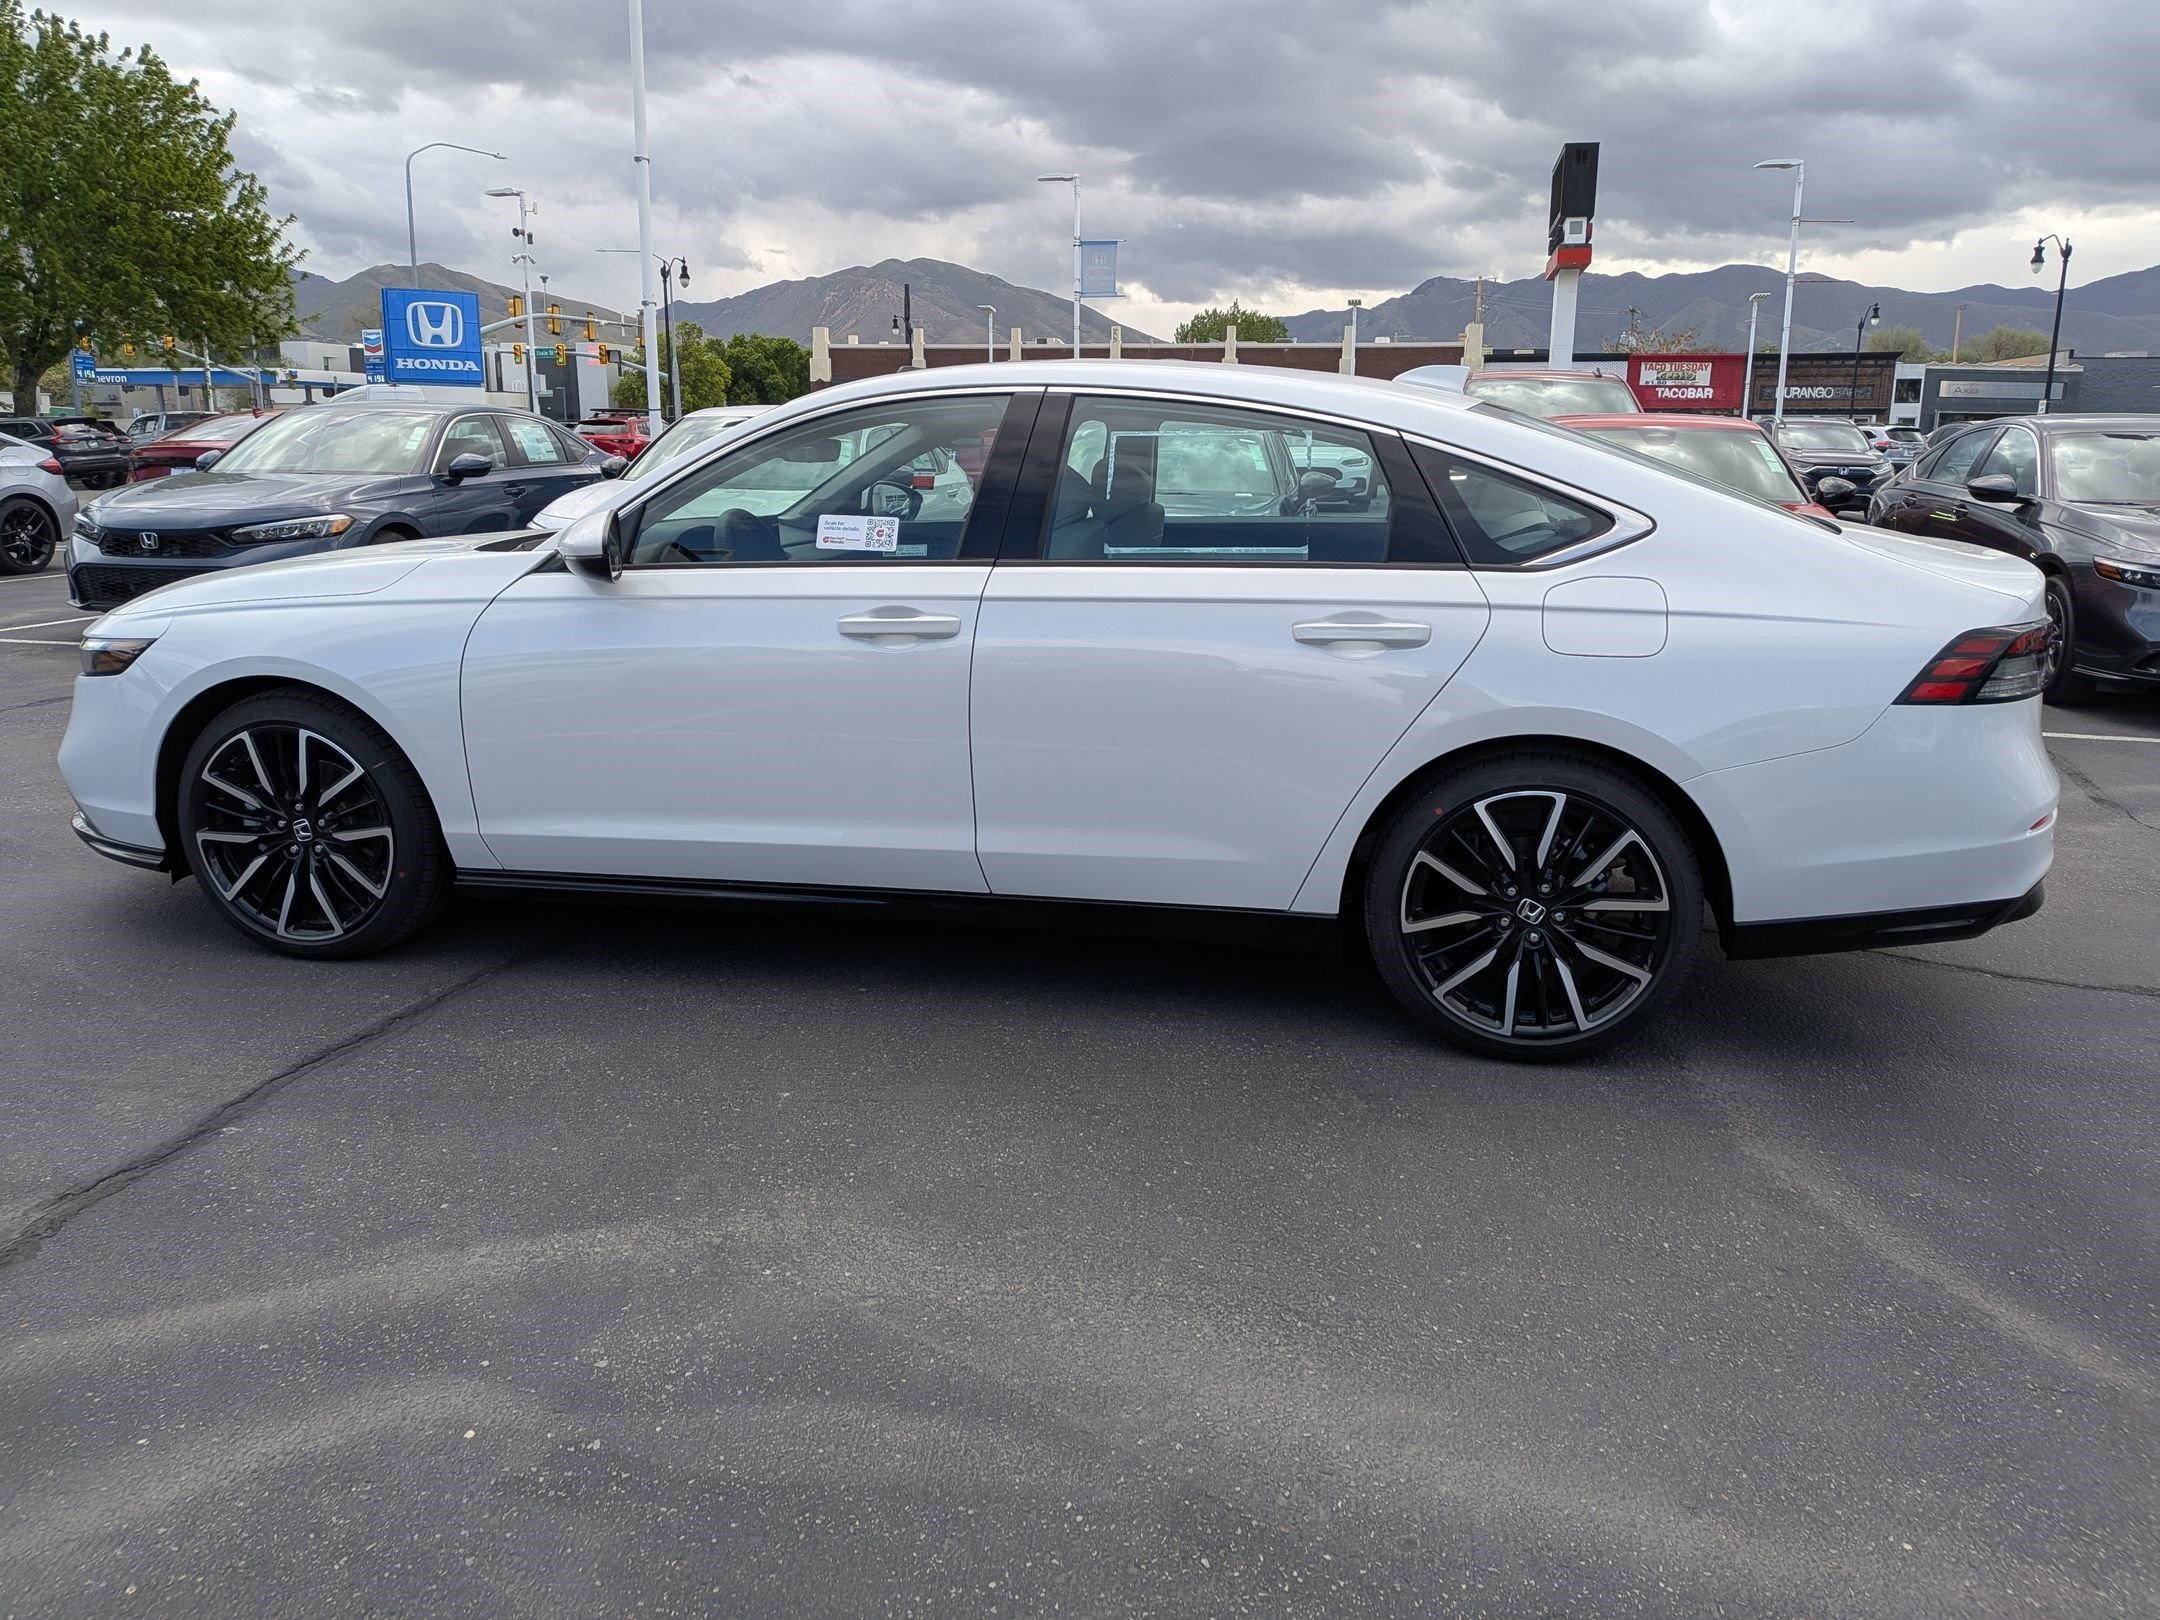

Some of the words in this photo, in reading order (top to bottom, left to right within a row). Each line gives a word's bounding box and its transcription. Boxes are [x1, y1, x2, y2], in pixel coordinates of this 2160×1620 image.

[395, 358, 480, 371] HONDA
[1643, 363, 1667, 371] TACO
[1669, 363, 1710, 372] TUESDAY
[1656, 387, 1713, 398] TACOBAR
[1952, 386, 1979, 394] Axis
